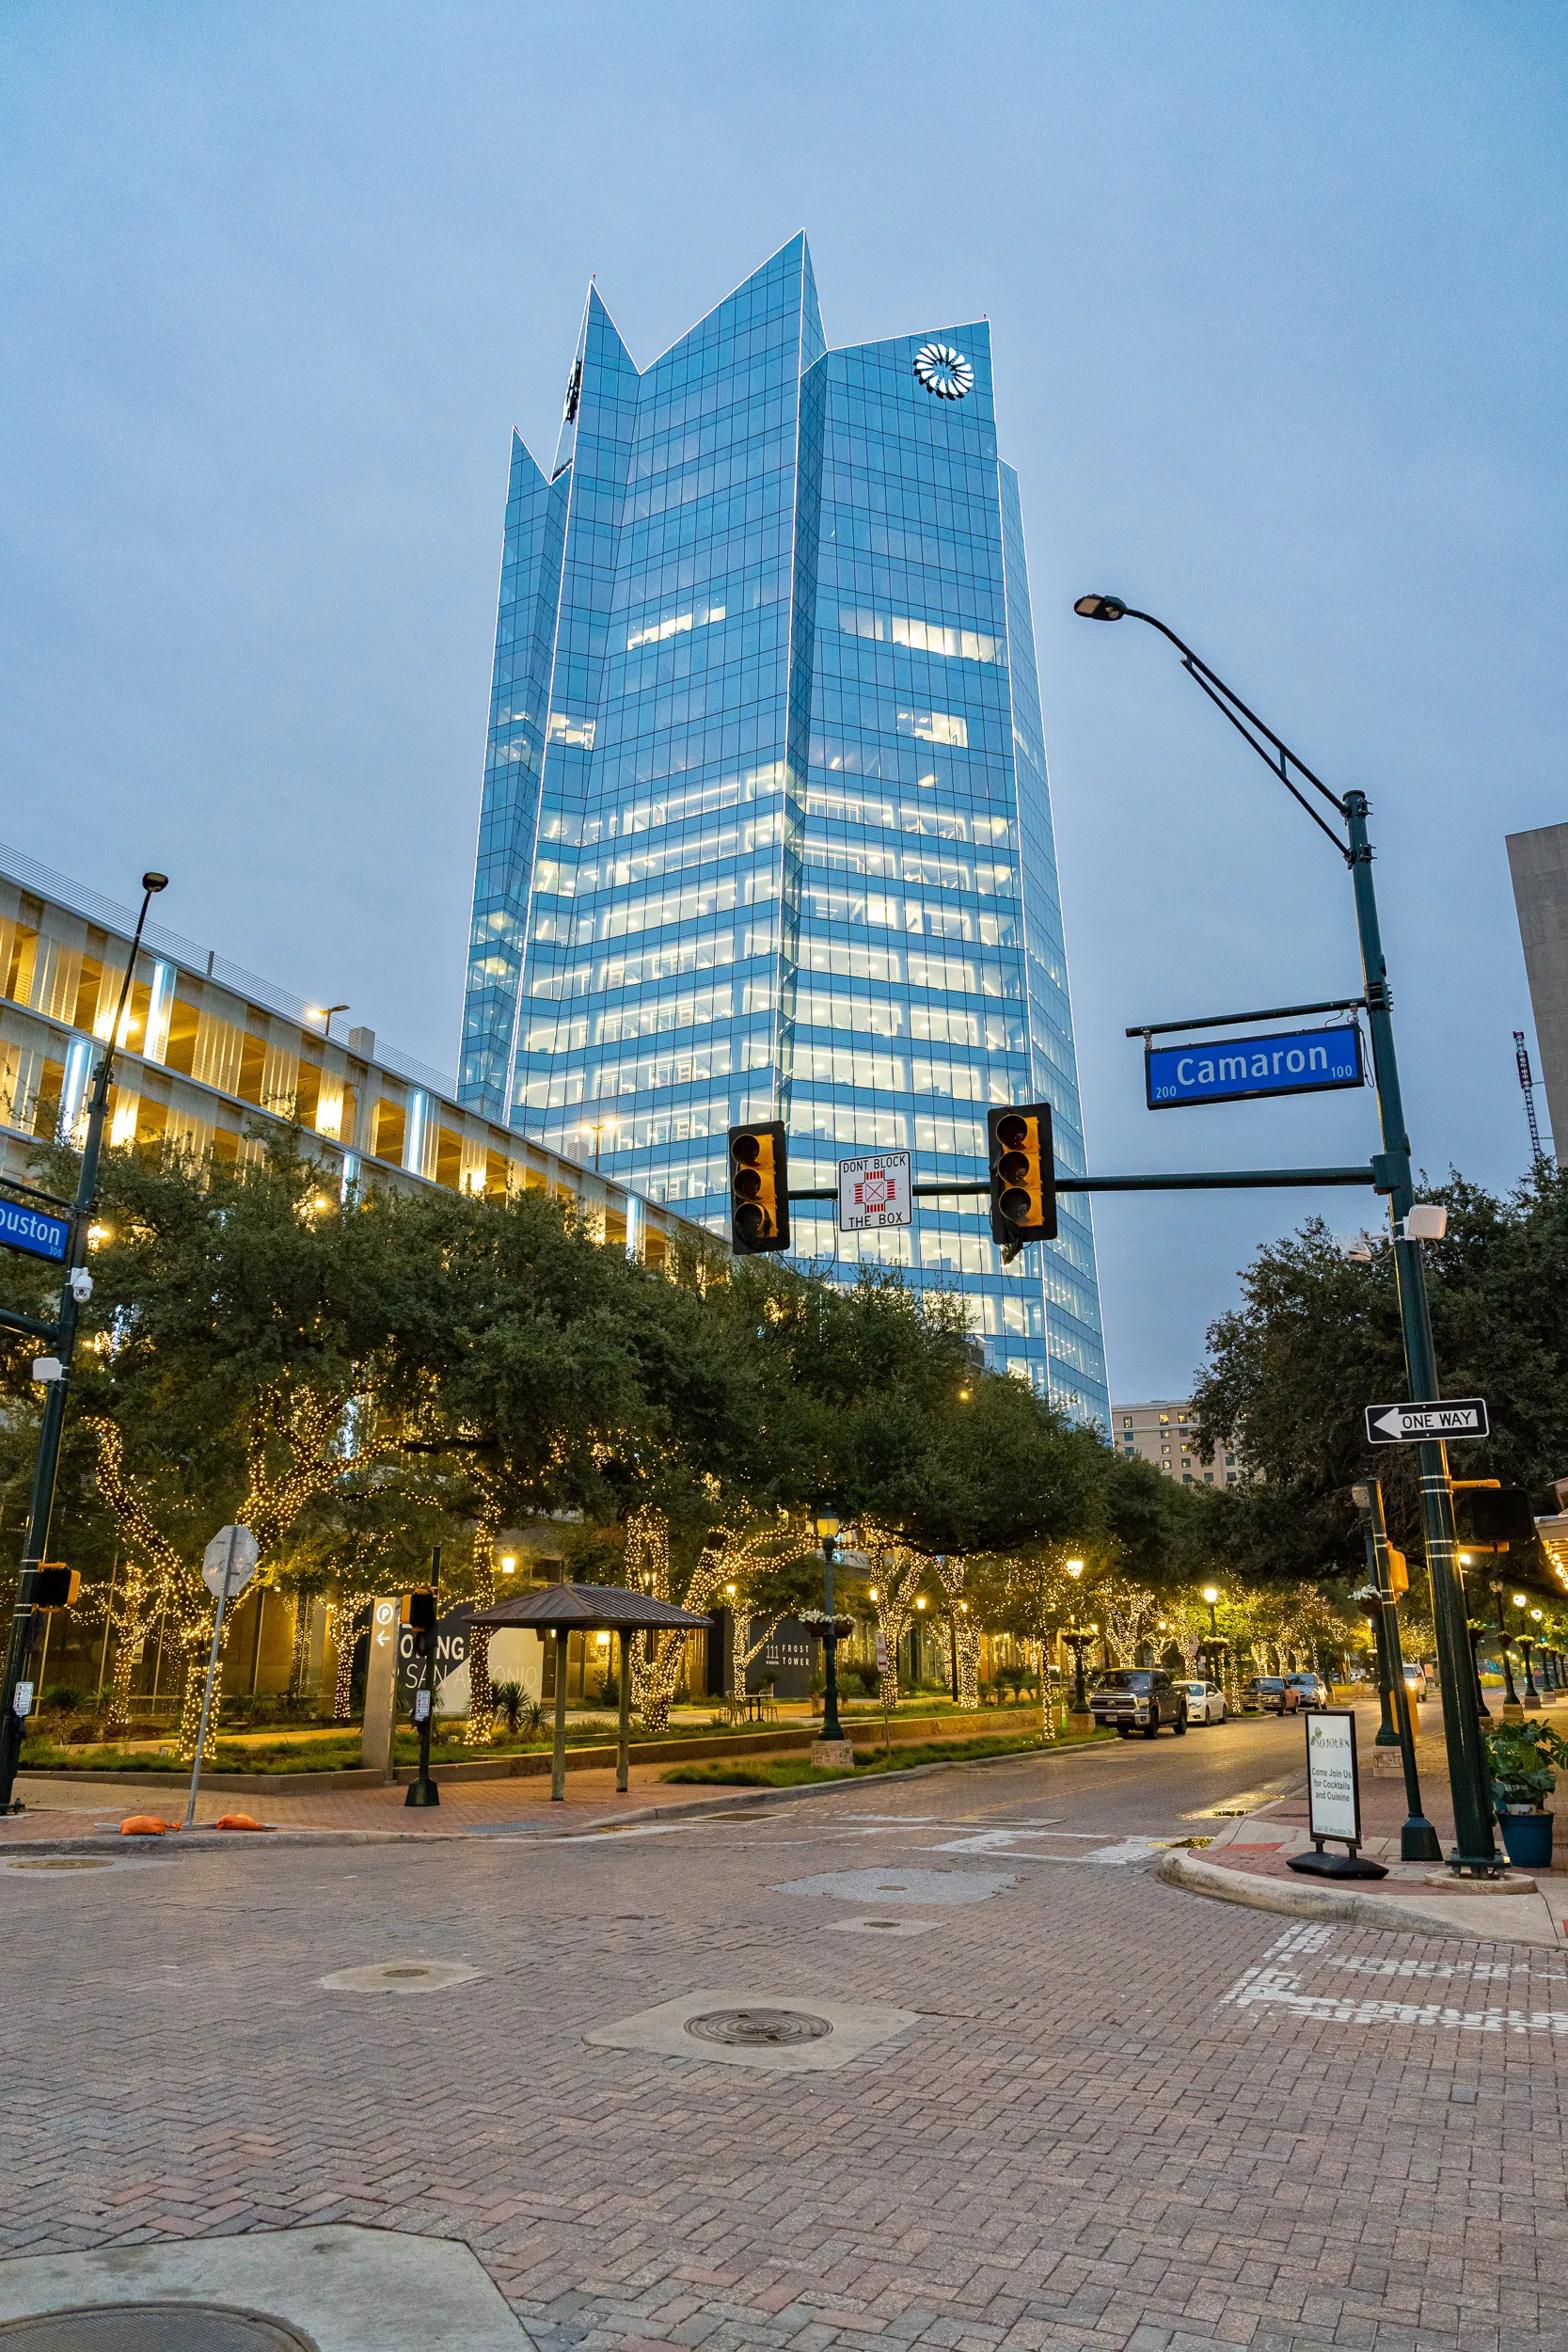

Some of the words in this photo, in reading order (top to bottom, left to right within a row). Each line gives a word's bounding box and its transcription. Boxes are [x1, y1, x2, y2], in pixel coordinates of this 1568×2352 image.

[1177, 1045, 1328, 1086] Camaron
[1331, 1064, 1353, 1078] 100
[1156, 1085, 1176, 1099] 200
[843, 1159, 869, 1173] DONT
[874, 1154, 906, 1169] BLOCK
[848, 1215, 871, 1228] THE
[879, 1212, 903, 1225] BOX
[49, 1245, 62, 1258] 300
[1402, 1414, 1434, 1429] ONE
[1439, 1411, 1472, 1427] WAY
[766, 1645, 779, 1659] 111
[782, 1644, 809, 1653] FROST
[782, 1657, 810, 1665] TOWER
[453, 1665, 537, 1689] AONIO
[1312, 1767, 1327, 1776] Come
[1329, 1769, 1342, 1777] Join
[1343, 1770, 1352, 1778] Us
[1313, 1779, 1322, 1788] for
[1323, 1779, 1351, 1789] Cocktails
[1327, 1791, 1350, 1802] Cuisine
